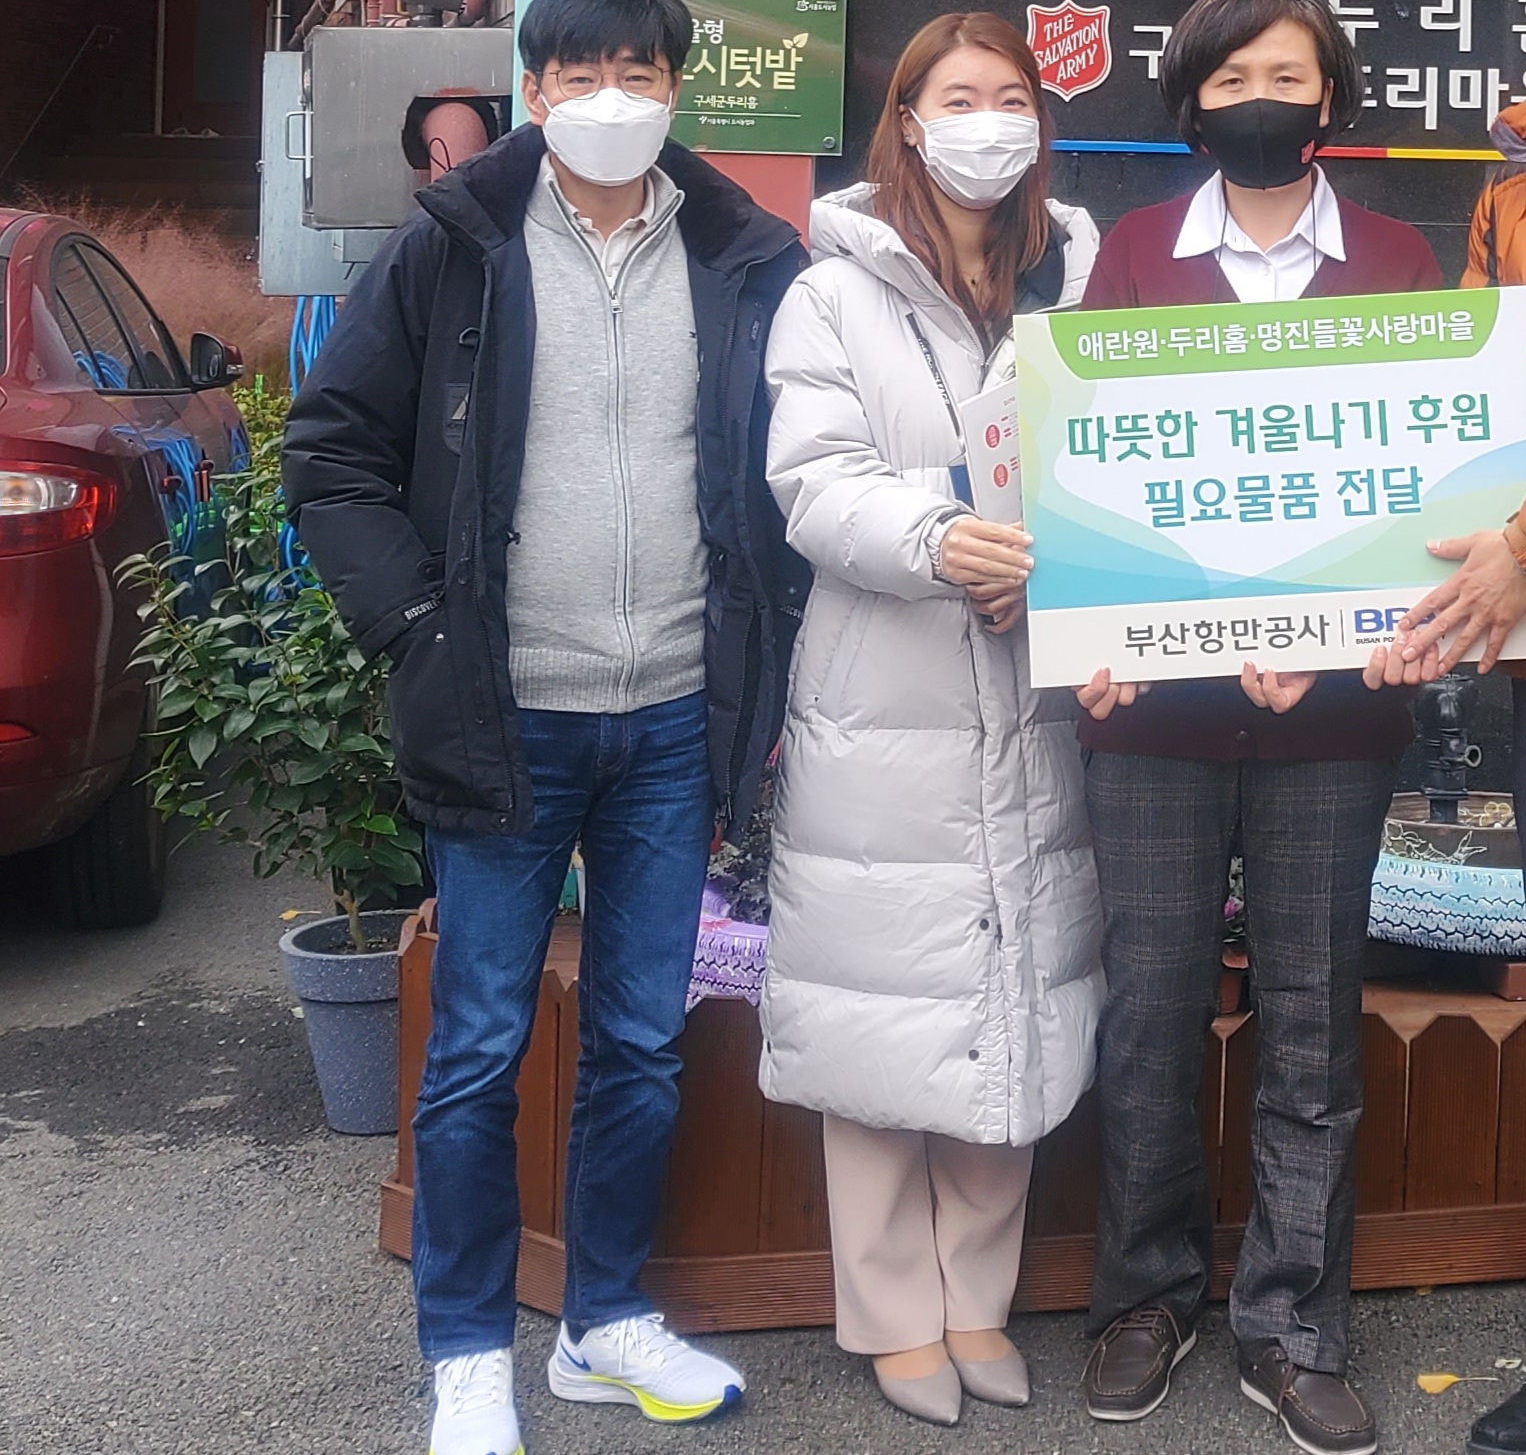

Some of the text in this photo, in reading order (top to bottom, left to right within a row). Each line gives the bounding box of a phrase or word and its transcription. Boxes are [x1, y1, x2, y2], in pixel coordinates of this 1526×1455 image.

[1034, 18, 1100, 71] SALVATION
[1043, 13, 1075, 42] THE
[1056, 44, 1098, 84] ARMY
[693, 94, 759, 109] 구세군두리홈
[1067, 408, 1199, 463] 따뜻한
[1215, 398, 1390, 454] 겨울나기
[1406, 392, 1493, 445] 후원
[1143, 465, 1424, 529] 필요물품 전달
[404, 599, 440, 621] DISCOVER
[1124, 613, 1331, 658] 부산항만공사
[1356, 636, 1380, 645] BUSAN
